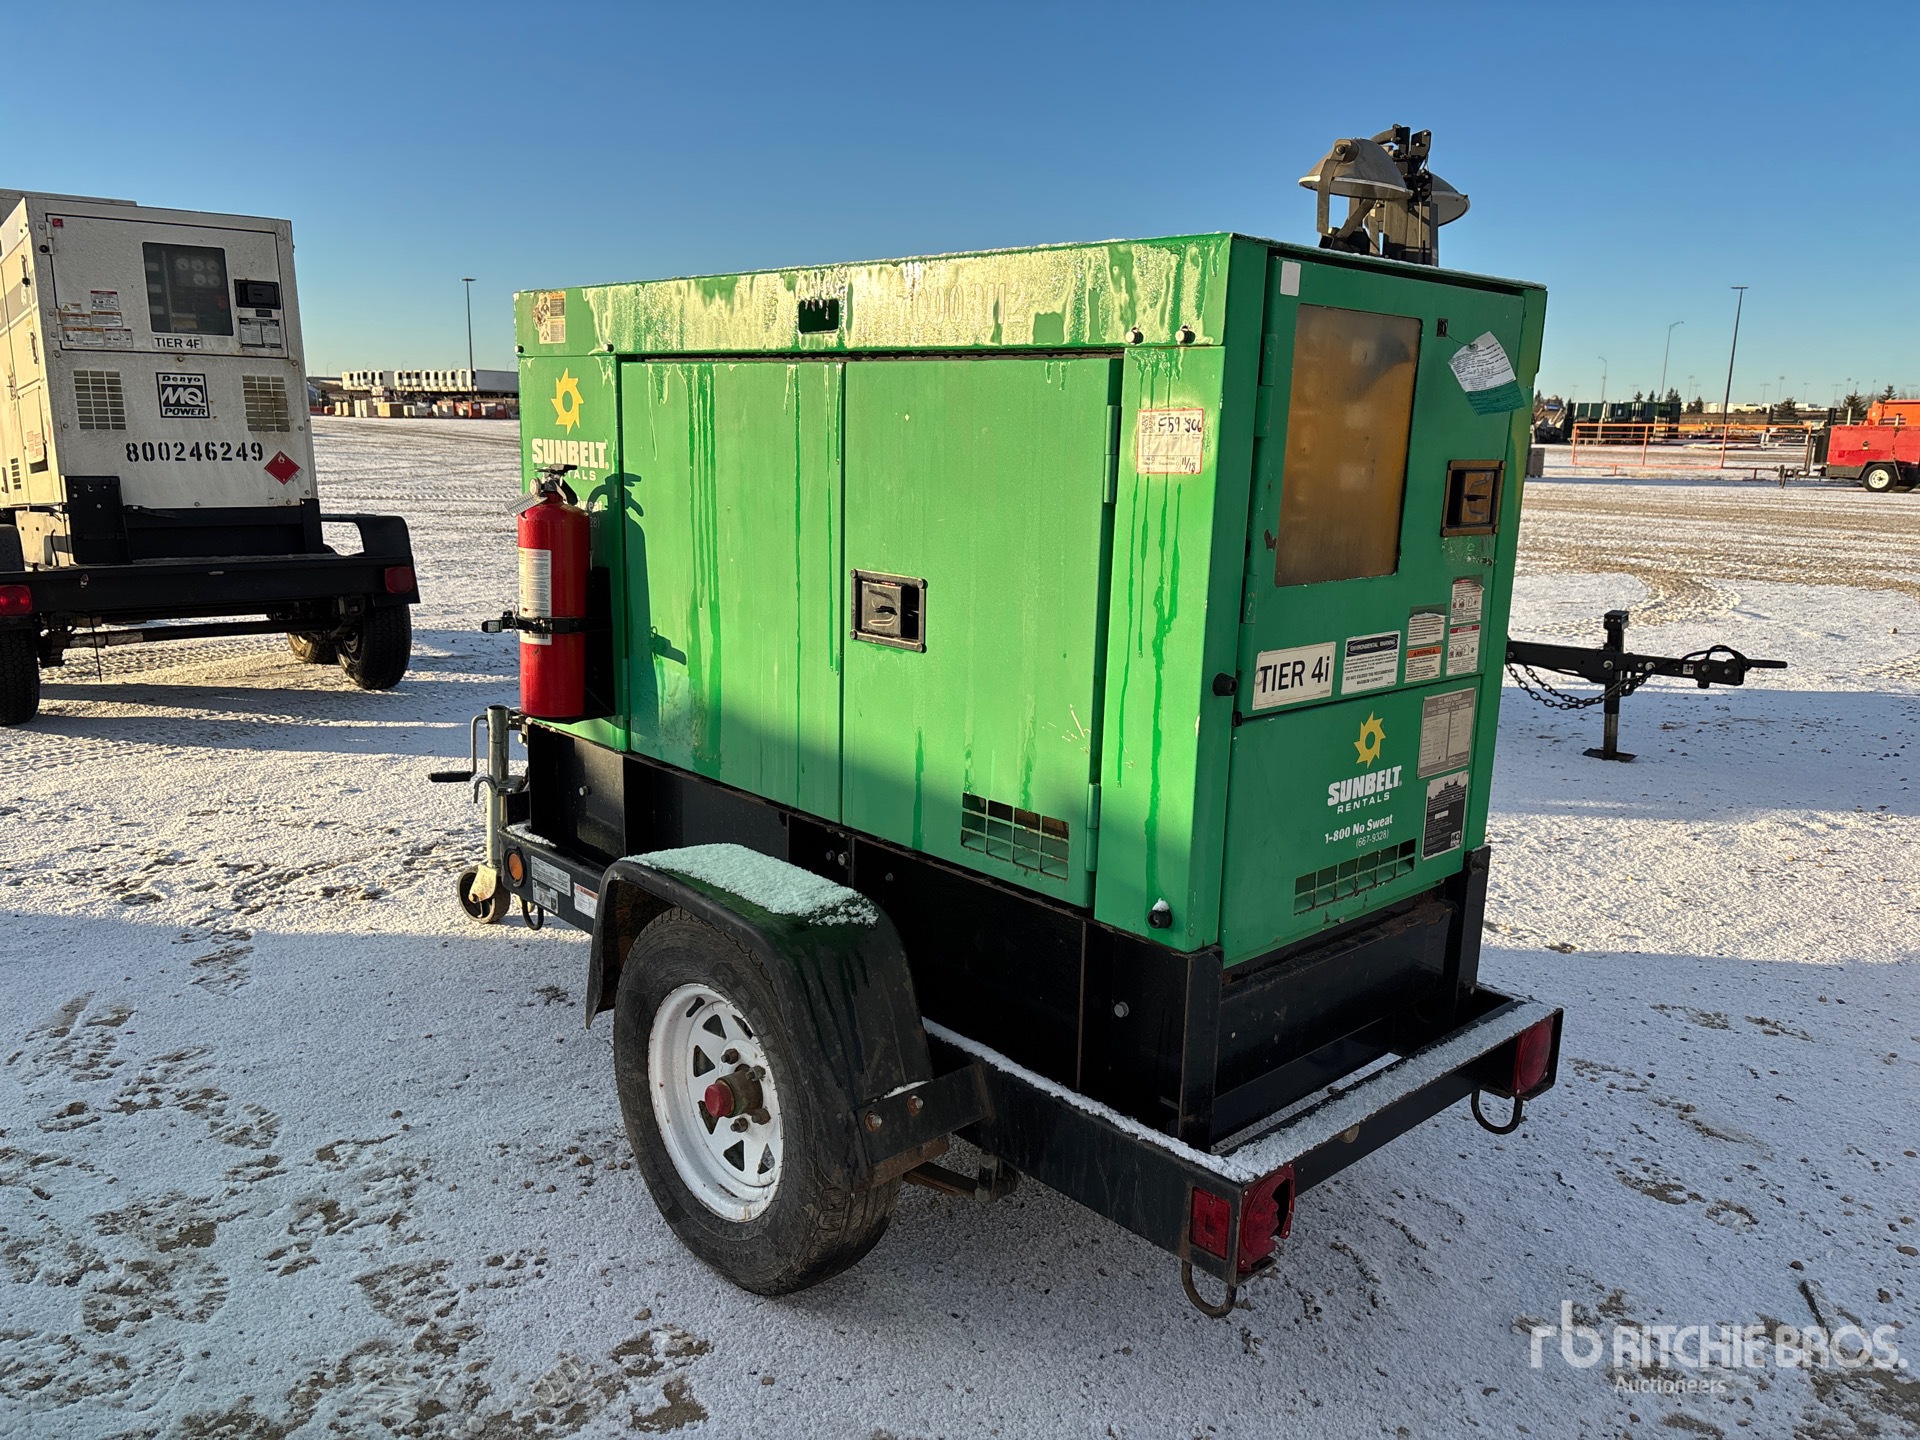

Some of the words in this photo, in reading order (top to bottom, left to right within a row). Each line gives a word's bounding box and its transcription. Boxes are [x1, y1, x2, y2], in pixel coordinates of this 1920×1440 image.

[154, 337, 183, 348] TIER
[185, 338, 201, 349] 4F
[162, 375, 201, 383] Denyo
[161, 386, 206, 406] MQ
[164, 407, 206, 416] POWER
[125, 441, 264, 463] 800246249
[532, 438, 607, 469] SUNBELT
[1260, 660, 1305, 693] TIER
[1311, 655, 1330, 683] 4i
[1327, 765, 1402, 806] SUNBELT
[1337, 792, 1390, 814] RENTALS
[1324, 826, 1351, 845] 1-800
[1352, 823, 1365, 836] No
[1366, 814, 1393, 832] Sweat
